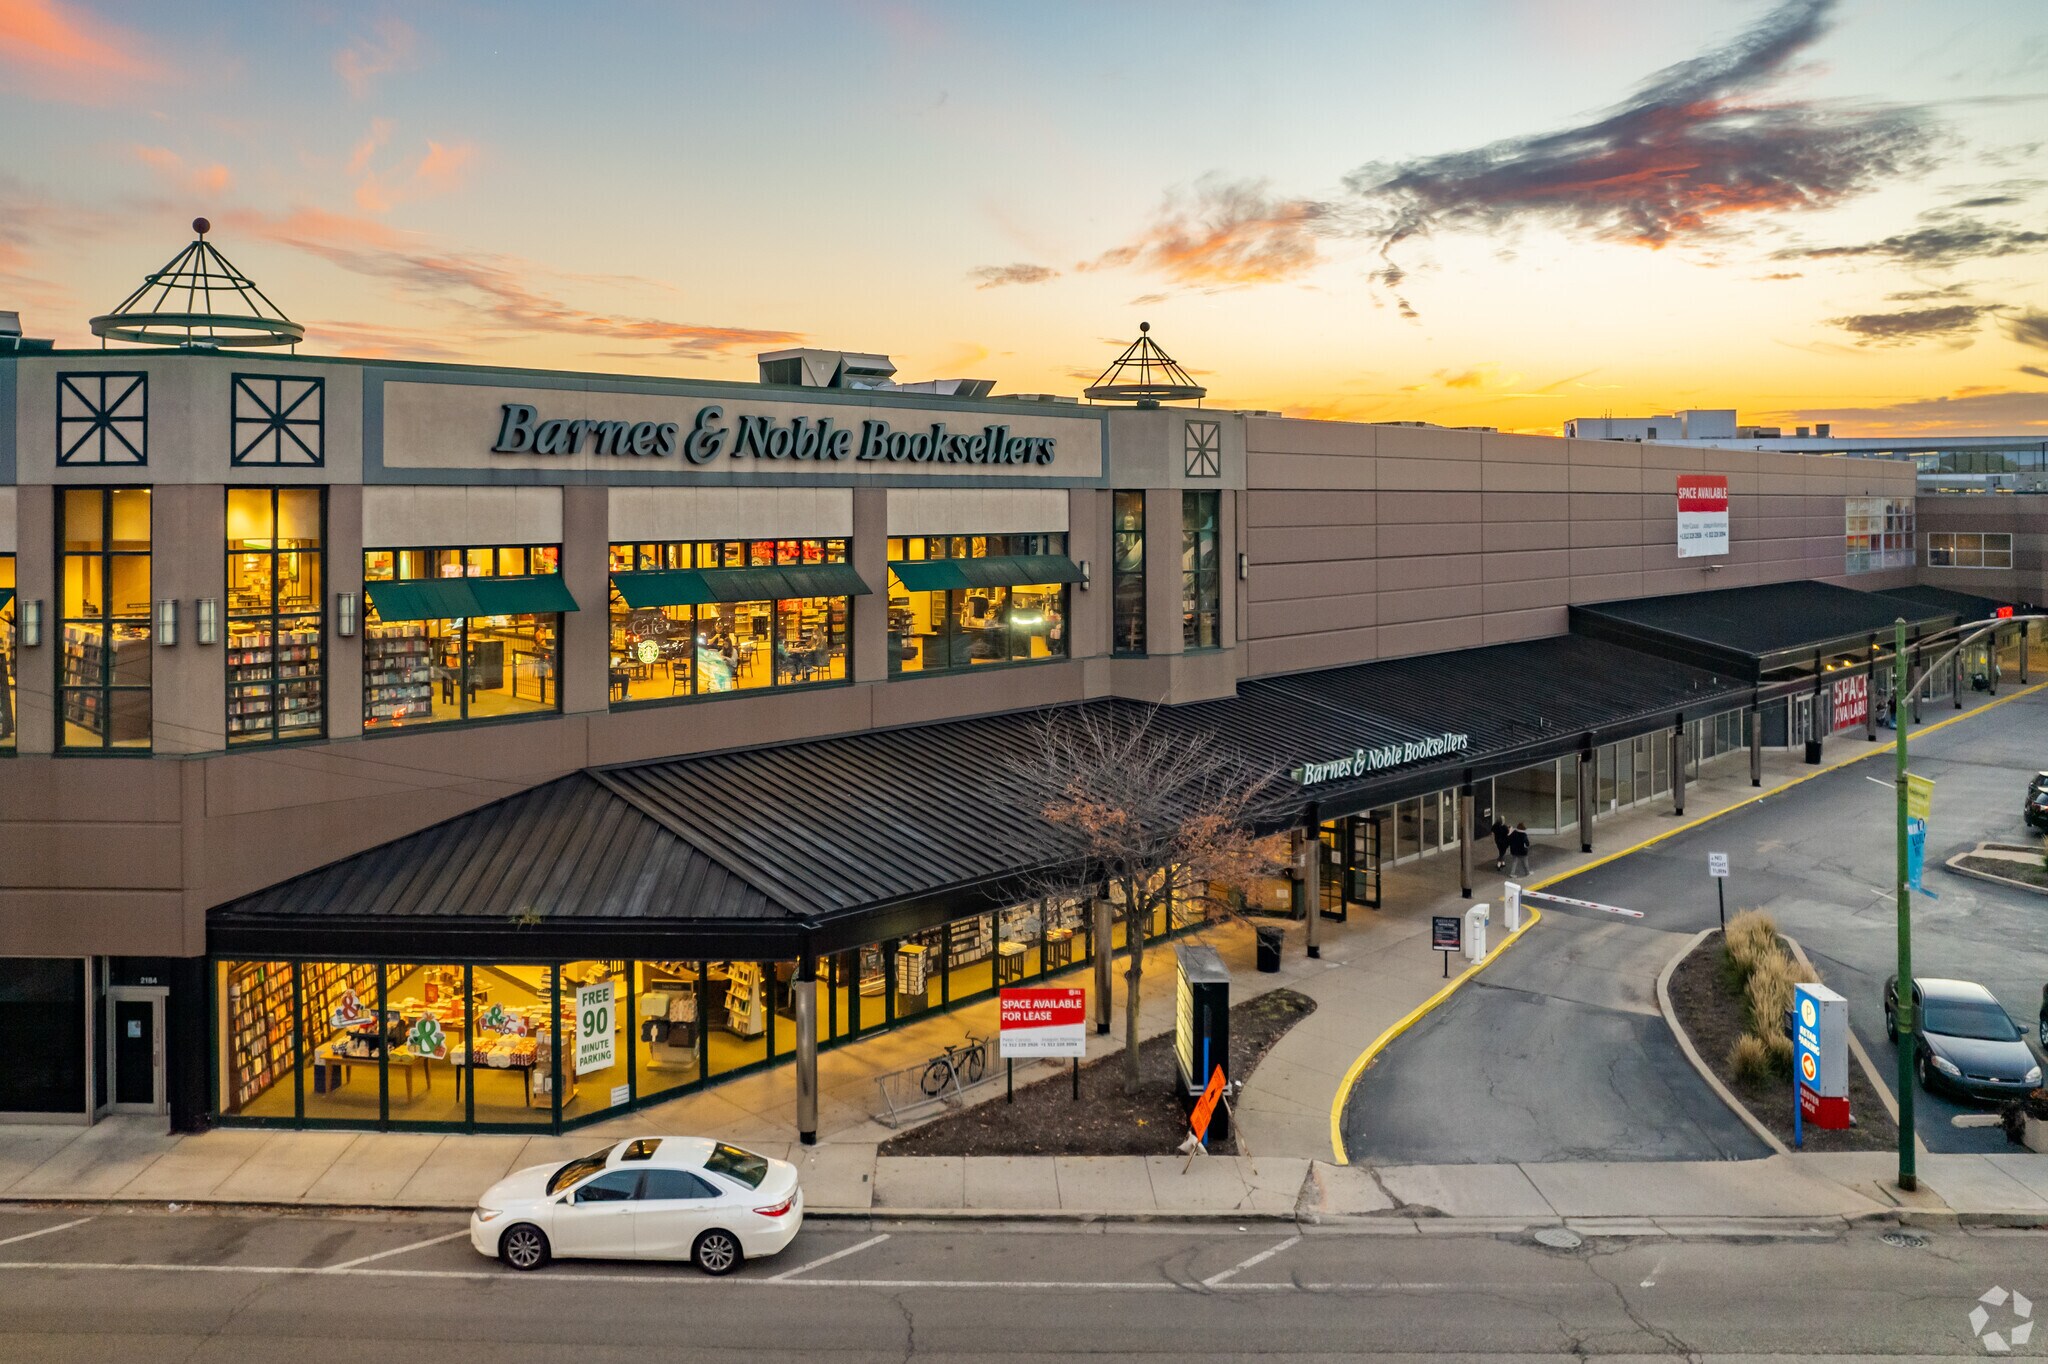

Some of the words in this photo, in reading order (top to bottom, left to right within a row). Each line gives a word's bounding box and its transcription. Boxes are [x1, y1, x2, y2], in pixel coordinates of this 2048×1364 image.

[493, 403, 678, 456] Barnes
[685, 405, 728, 464] &
[733, 414, 855, 462] Noble
[858, 419, 1058, 465] Booksellers
[1679, 487, 1697, 499] SPACE
[1698, 487, 1728, 499] AVAILABLE
[1303, 759, 1352, 786] Barnes
[1353, 749, 1366, 777] &
[1367, 747, 1402, 771] Noble
[1403, 733, 1468, 763] Booksellers
[582, 988, 609, 1007] FREE
[1002, 999, 1031, 1009] SPACE
[1033, 999, 1082, 1009] AVAILABLE
[583, 1007, 608, 1038] 90
[1002, 1011, 1021, 1022] FOR
[1023, 1011, 1052, 1021] LEASE
[581, 1039, 609, 1055] MINUTE
[579, 1050, 612, 1067] PARKING
